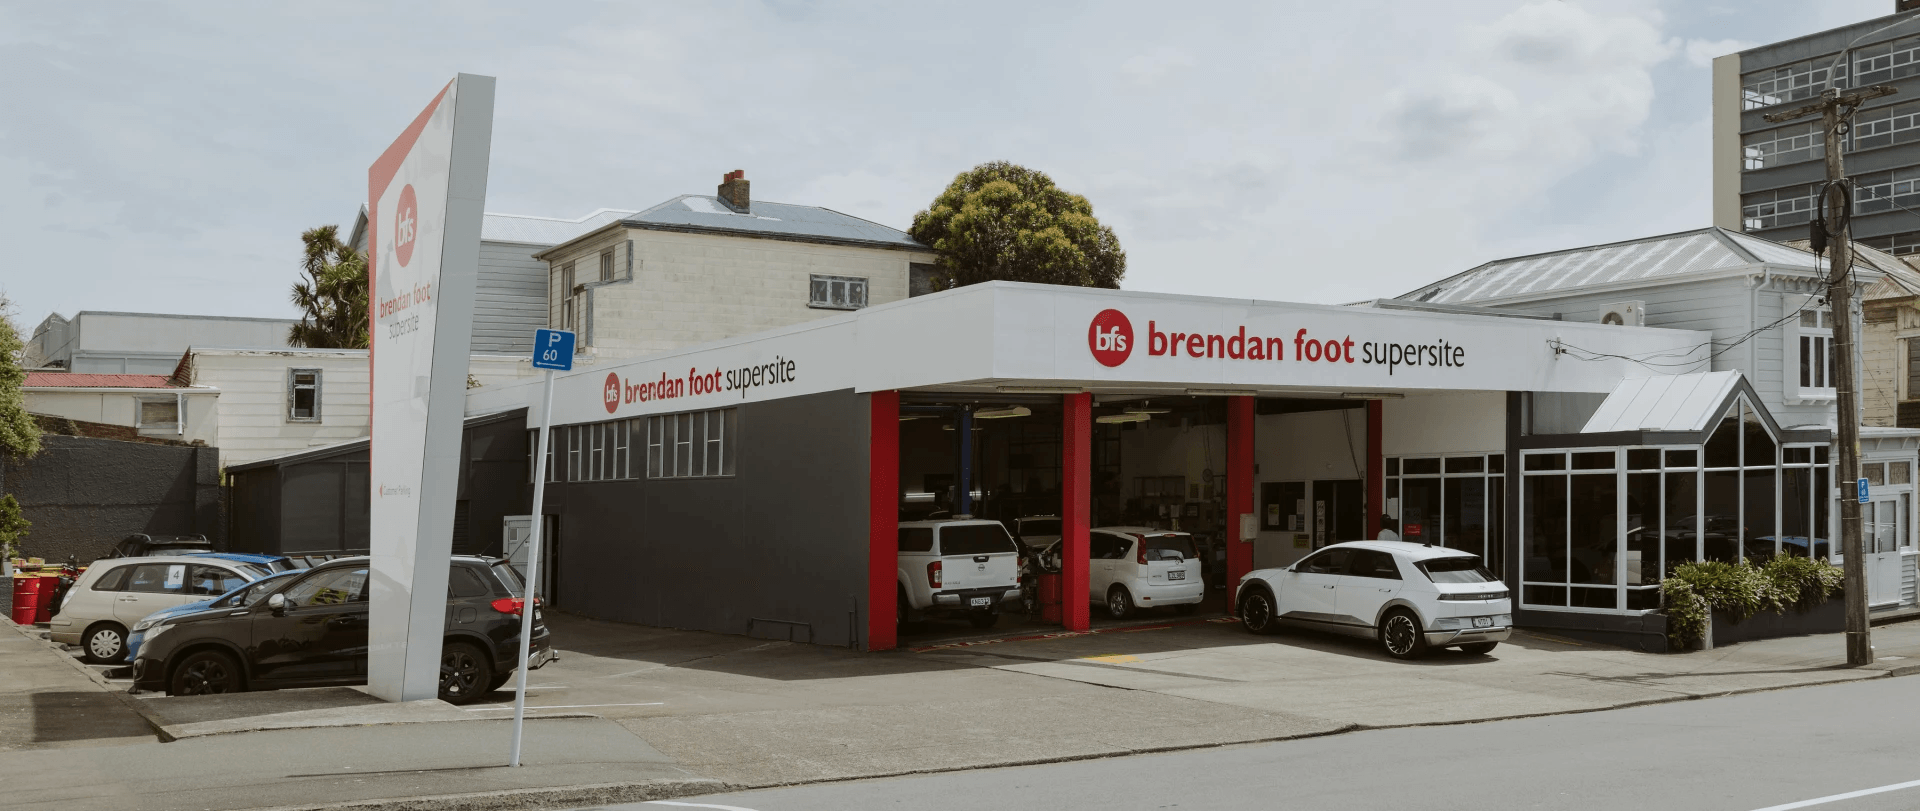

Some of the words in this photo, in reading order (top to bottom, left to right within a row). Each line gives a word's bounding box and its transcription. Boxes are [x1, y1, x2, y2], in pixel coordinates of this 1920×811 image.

[397, 207, 414, 247] bfs
[380, 288, 411, 319] brendan
[413, 280, 431, 306] foot
[389, 312, 419, 344] supersite
[548, 332, 562, 347] P
[542, 349, 558, 361] 60
[1096, 325, 1127, 352] bfs
[1148, 320, 1283, 361] brendan
[1294, 328, 1355, 364] foot
[1362, 338, 1465, 375] supersite
[606, 383, 618, 403] bfs
[625, 371, 684, 404] brendan
[688, 366, 722, 396] foot
[726, 355, 796, 399] supersite
[173, 569, 180, 580] 4
